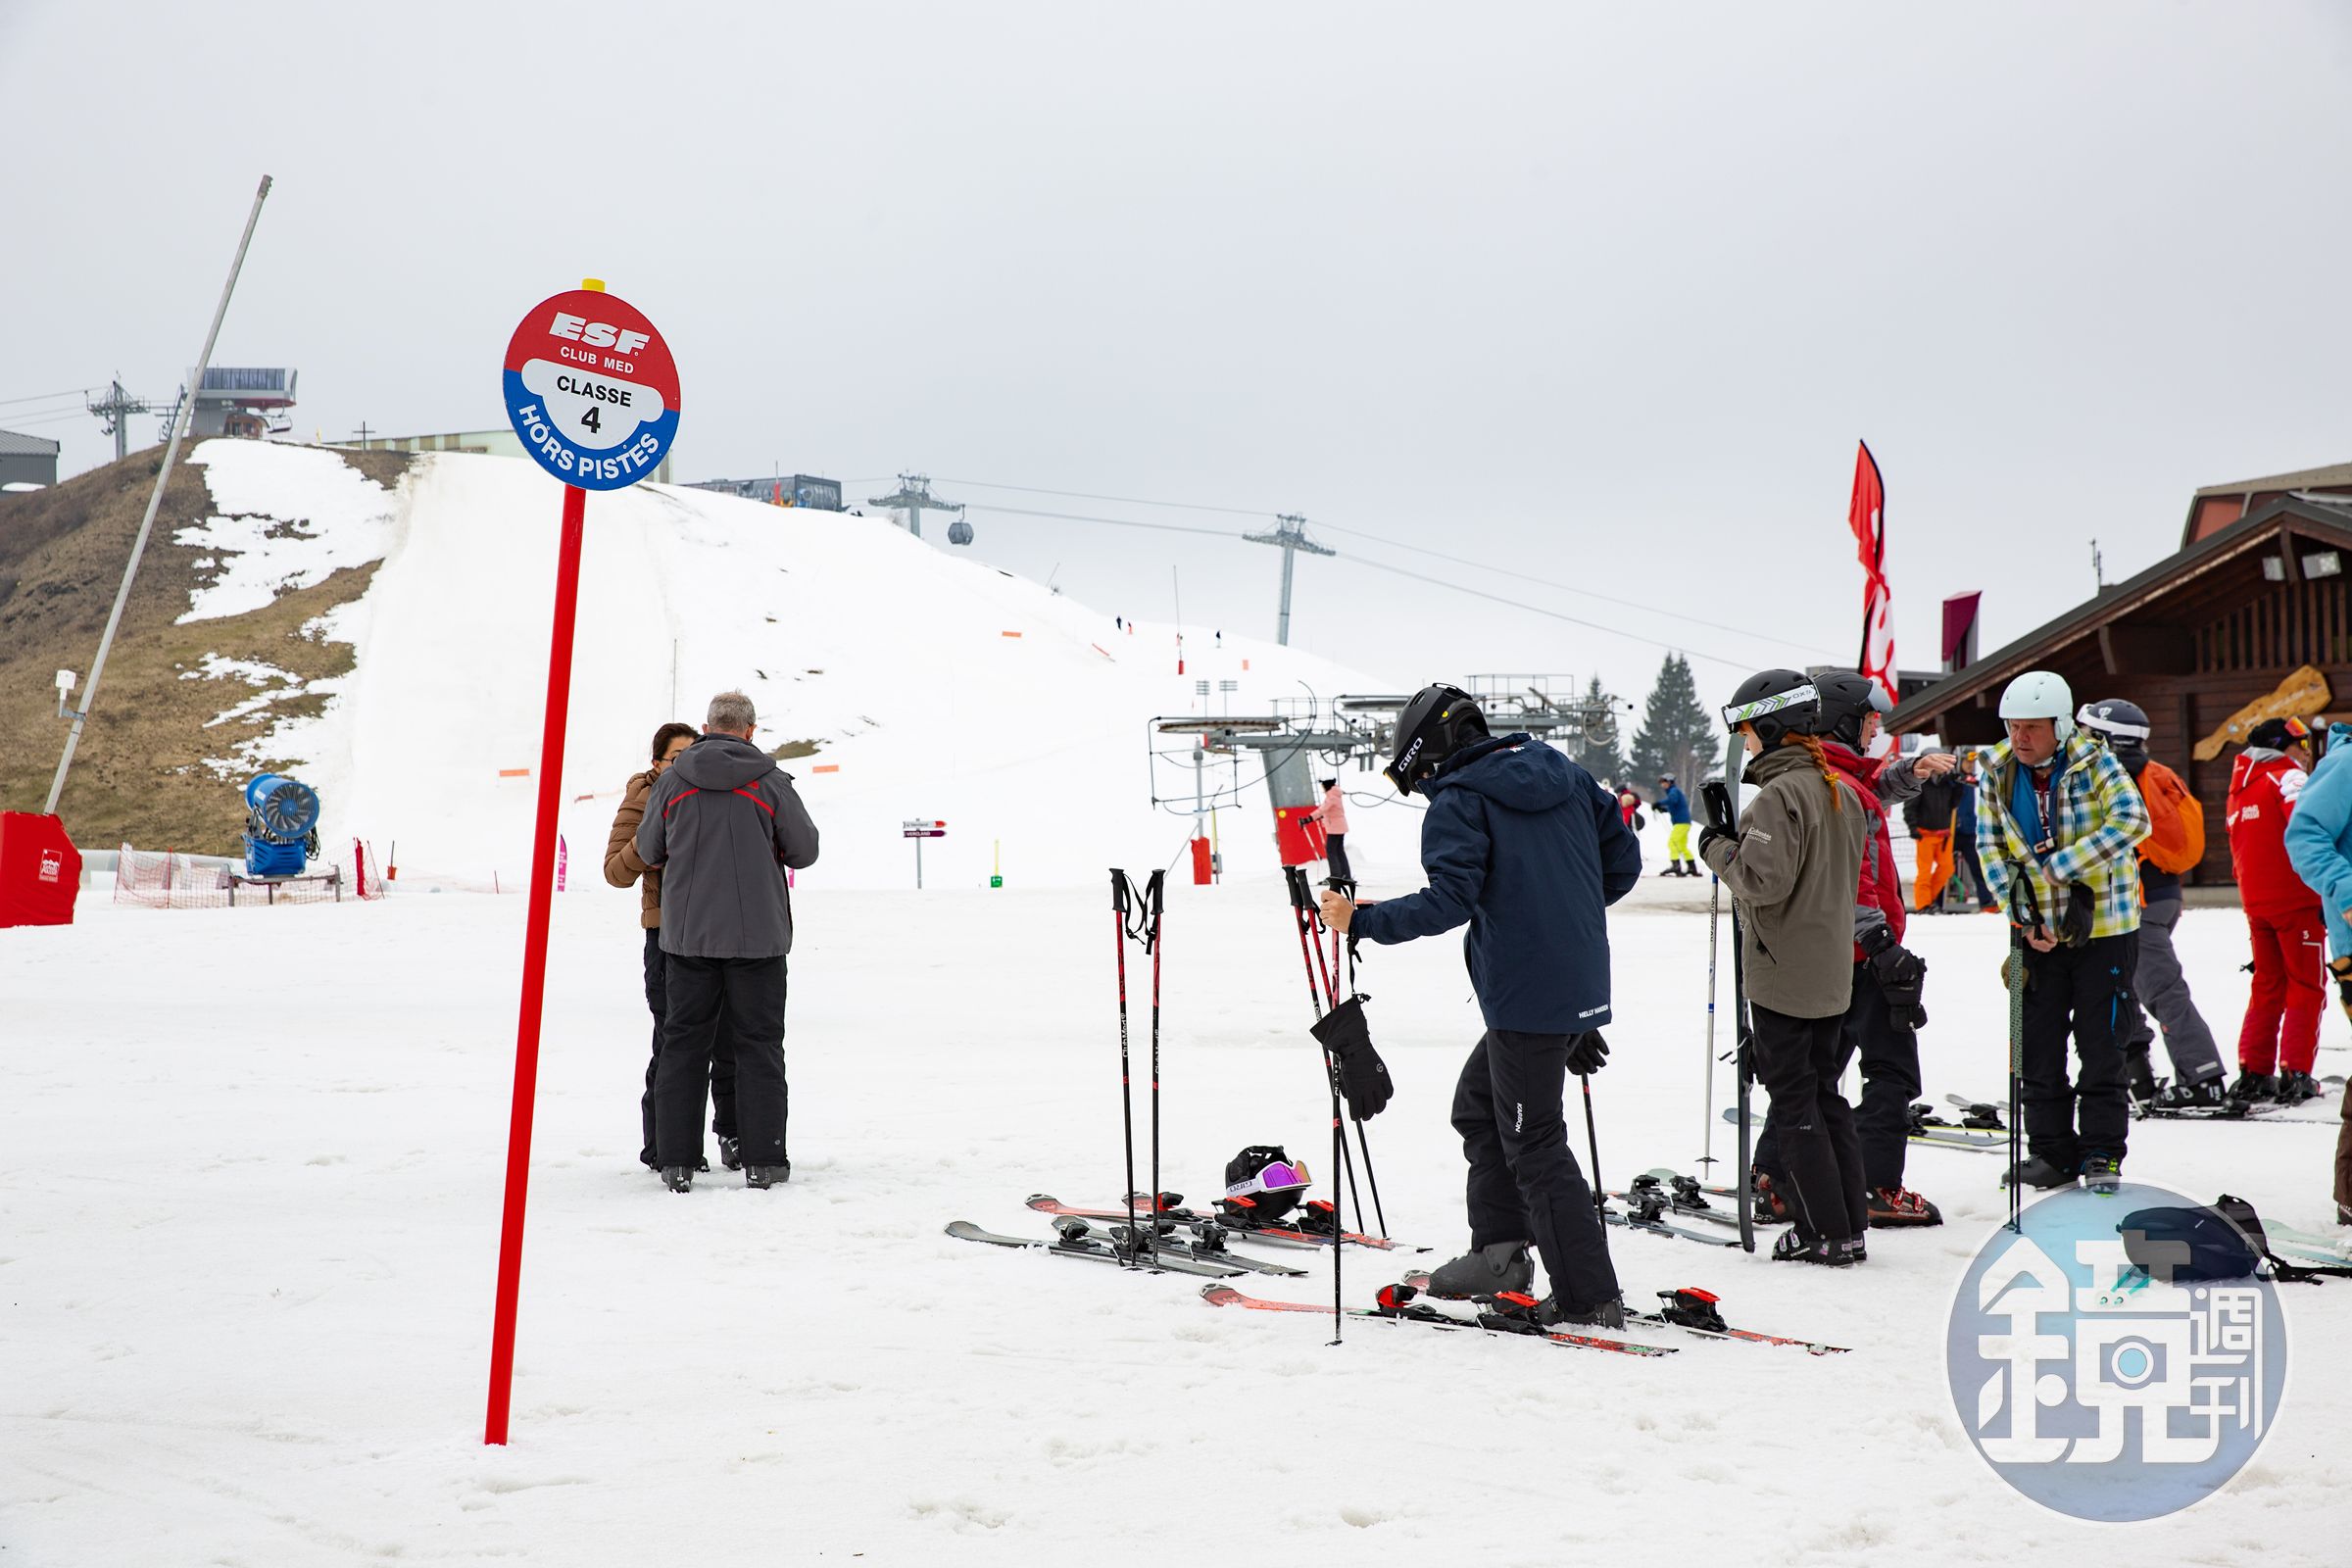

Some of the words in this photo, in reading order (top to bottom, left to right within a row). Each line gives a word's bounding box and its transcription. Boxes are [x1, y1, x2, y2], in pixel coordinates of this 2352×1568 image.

[549, 312, 651, 355] ESF
[561, 347, 597, 365] CLUB
[604, 357, 634, 374] MED
[557, 376, 632, 408] CLASSE
[581, 407, 601, 434] 4
[519, 404, 574, 471] HORS
[579, 433, 660, 480] PISTES
[1398, 737, 1423, 772] GIRO
[1579, 1009, 1594, 1019] HELLY
[1229, 1180, 1252, 1193] GIRO
